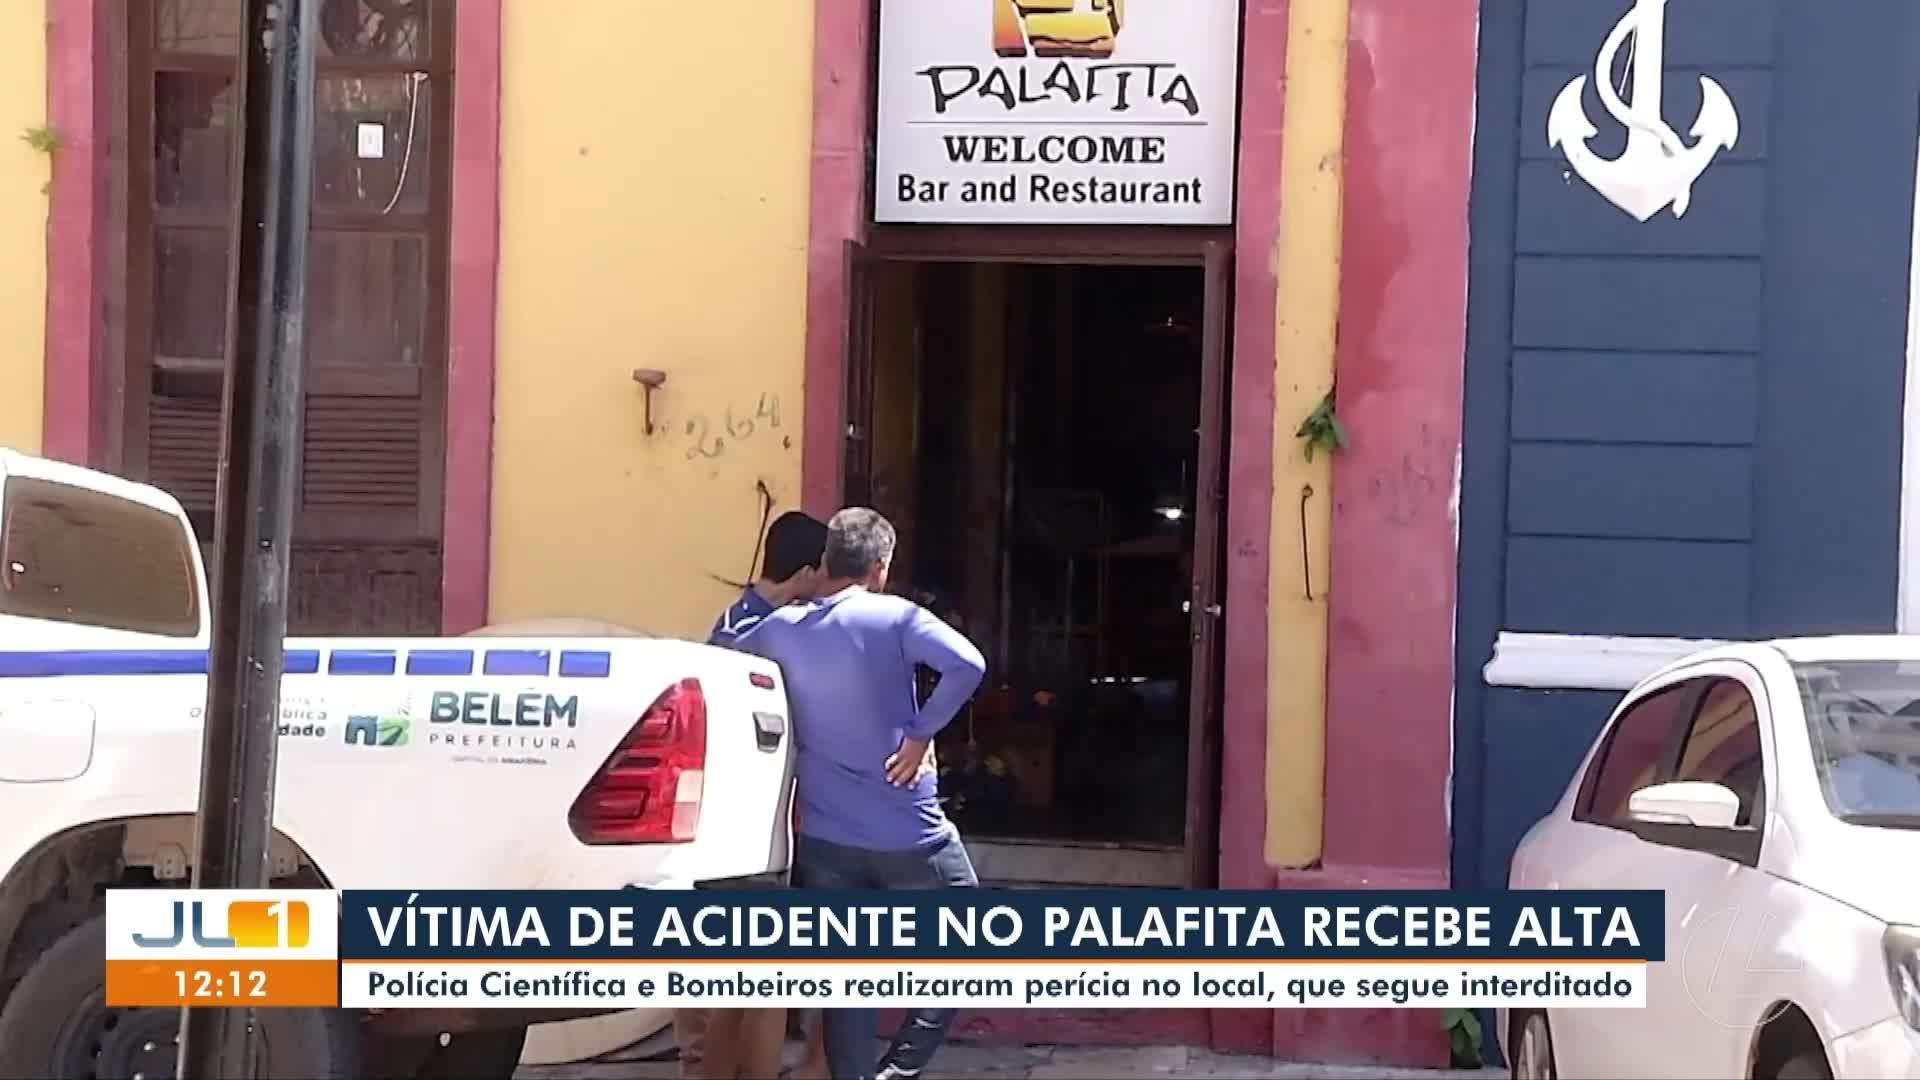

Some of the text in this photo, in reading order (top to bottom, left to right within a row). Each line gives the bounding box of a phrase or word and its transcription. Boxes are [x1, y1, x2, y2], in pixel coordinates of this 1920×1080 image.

[916, 61, 1199, 116] PALAFITA
[943, 135, 1165, 164] WELCOME
[898, 173, 1202, 204] Bar and Restaurant
[429, 687, 578, 729] BELÉM
[429, 733, 577, 750] PREFEITURA
